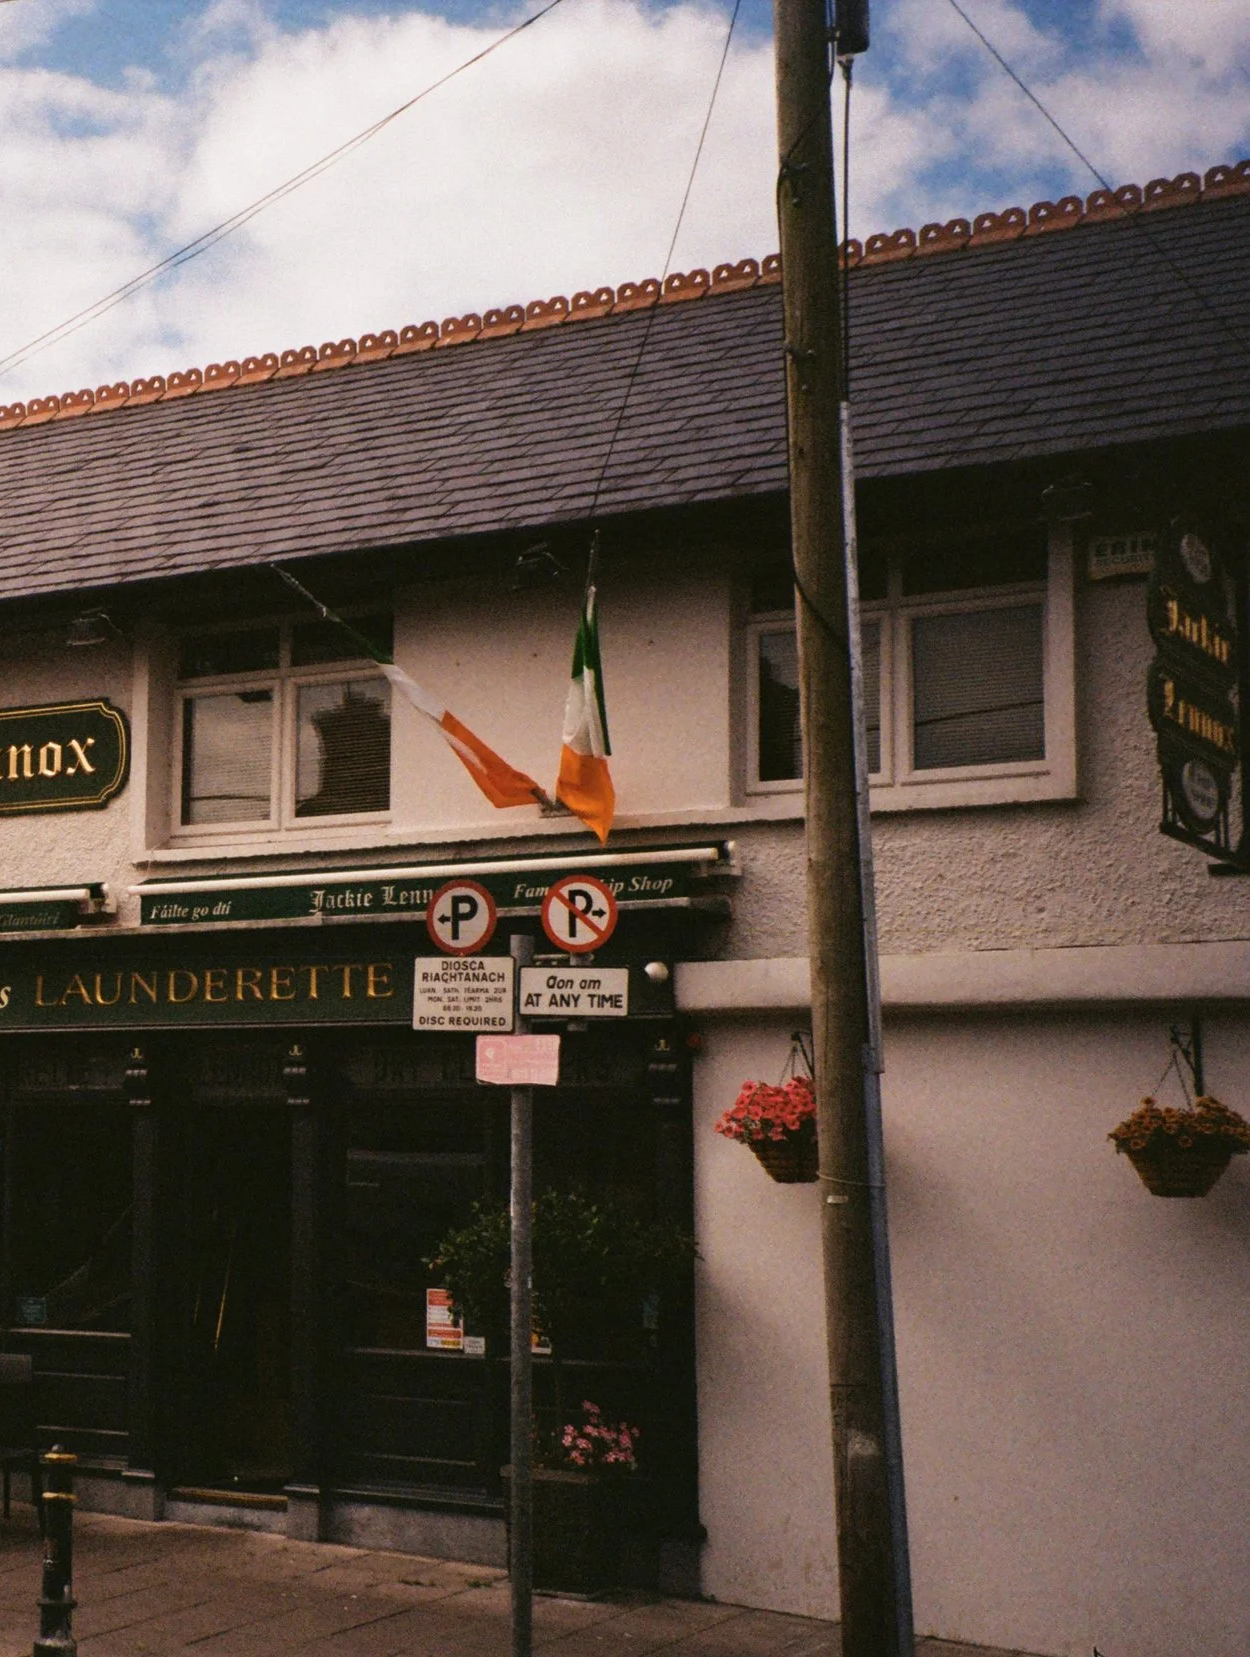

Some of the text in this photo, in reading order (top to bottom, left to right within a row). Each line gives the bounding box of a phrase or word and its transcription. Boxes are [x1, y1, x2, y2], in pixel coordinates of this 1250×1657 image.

[627, 874, 673, 894] Shop
[310, 885, 433, 916] Jackie Lenn
[193, 906, 209, 922] go
[441, 960, 485, 972] DIOSCA
[35, 962, 394, 1007] LAUNDERETTE
[422, 972, 505, 983] RIACHTANACH
[579, 978, 601, 990] am
[524, 993, 623, 1009] AT ANY TIME
[419, 1016, 506, 1027] DISC REQUIRED
